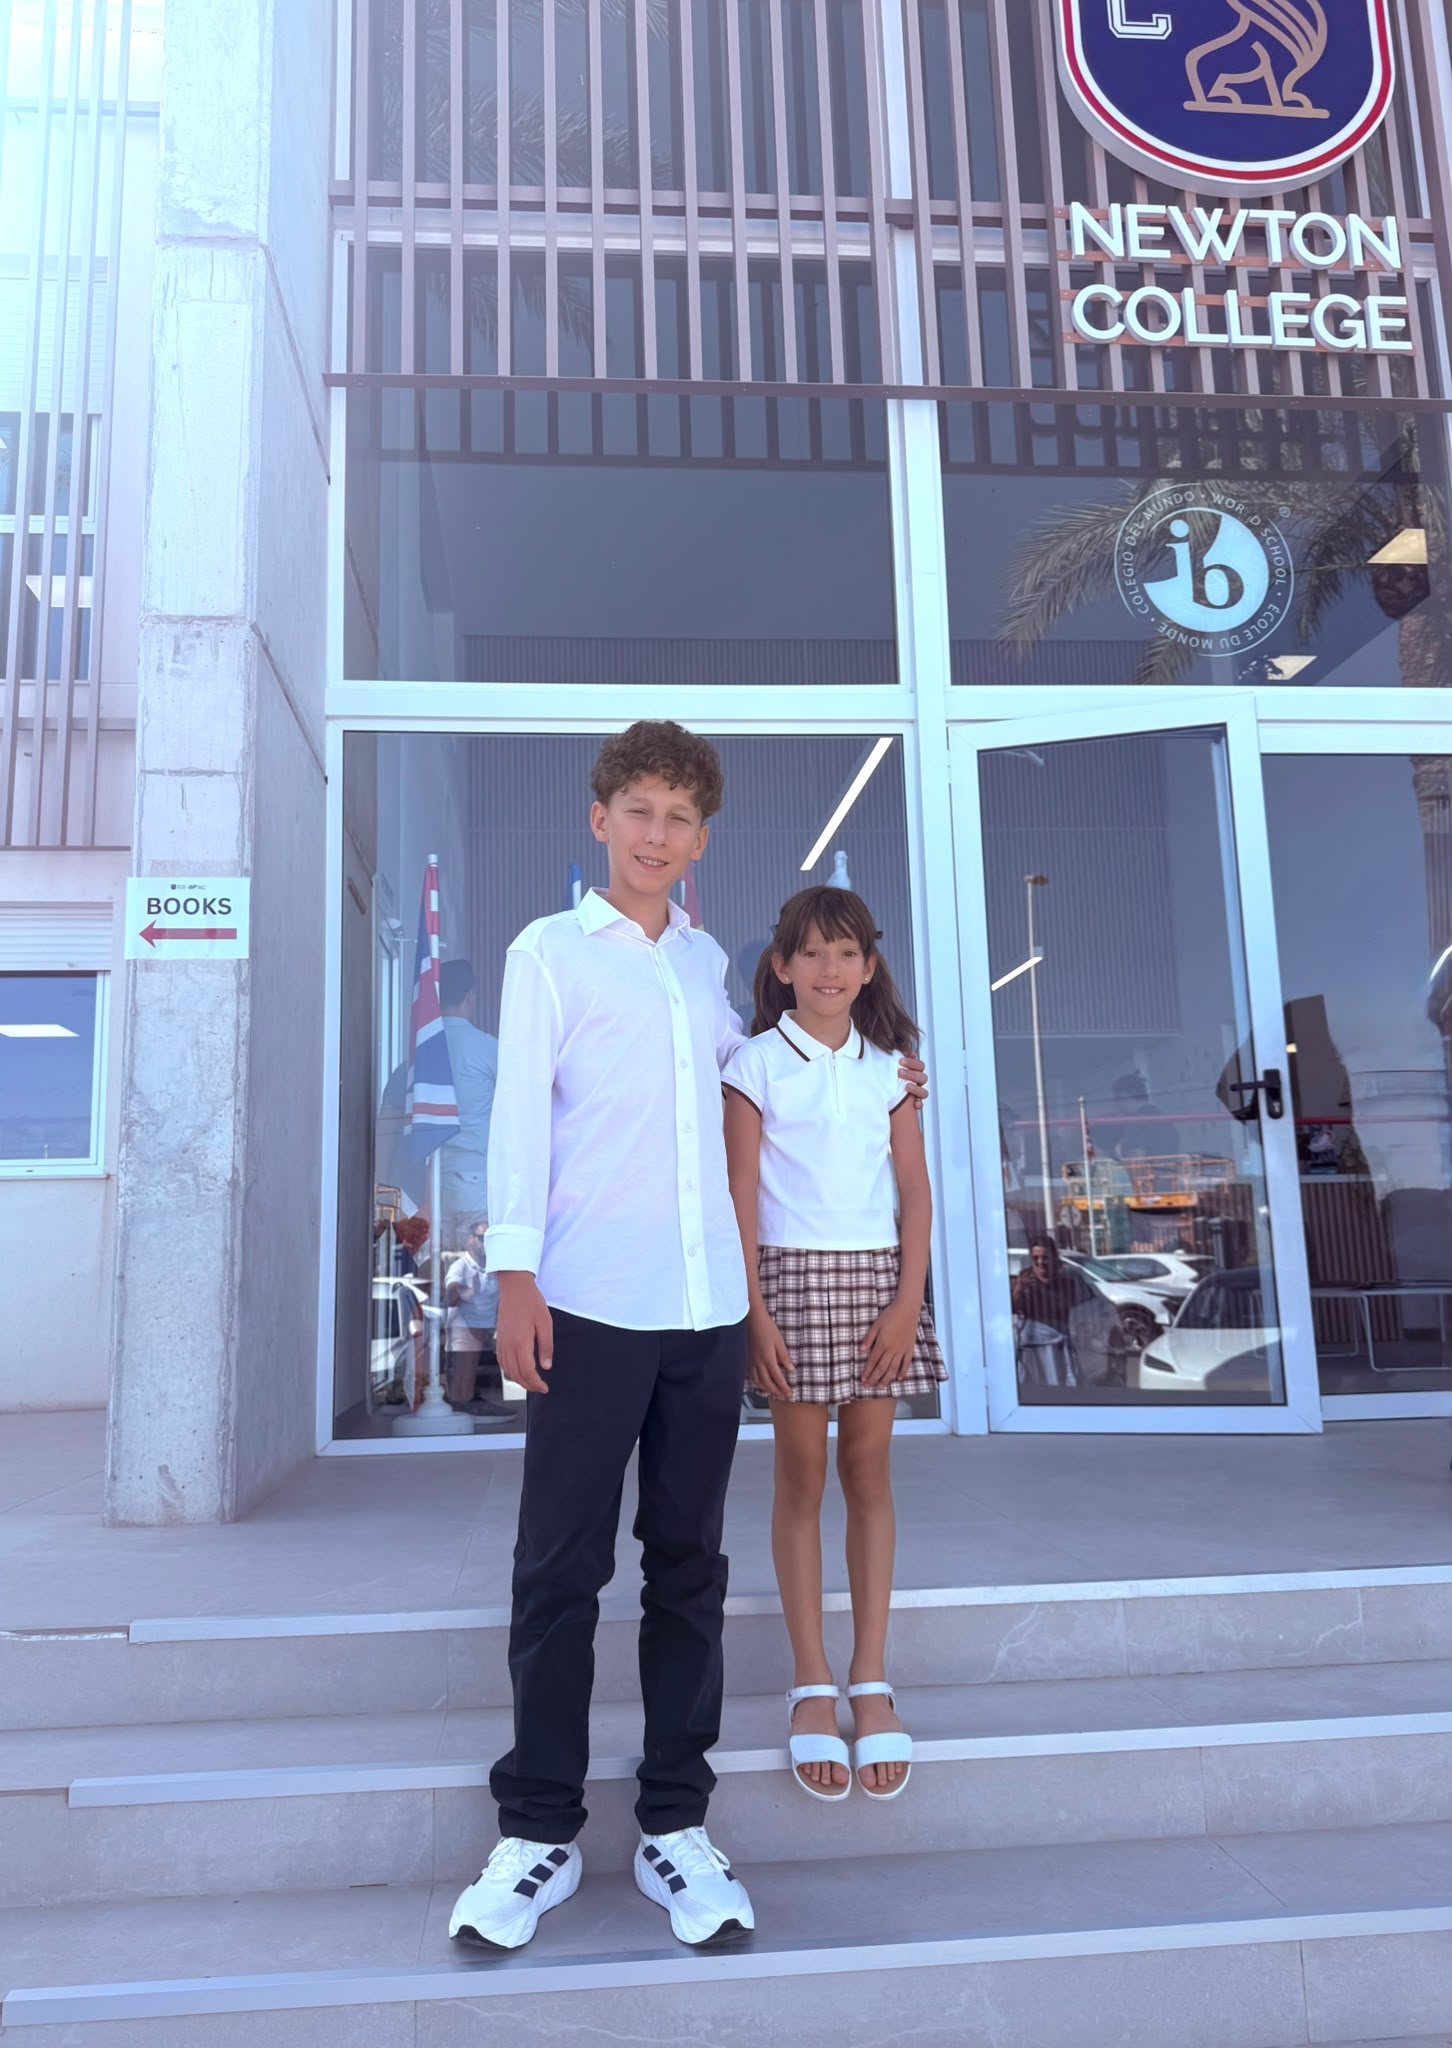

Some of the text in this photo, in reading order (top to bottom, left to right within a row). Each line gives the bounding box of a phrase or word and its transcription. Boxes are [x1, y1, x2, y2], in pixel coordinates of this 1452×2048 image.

[1070, 201, 1402, 271] NEWTON
[1071, 284, 1413, 352] COLLEGE
[1122, 491, 1195, 614] COLEGIO DEL MUNDO
[1212, 492, 1287, 585] WORD SCHOOL
[1157, 622, 1213, 649] MONDE
[1220, 634, 1241, 649] DU
[147, 897, 232, 915] BOOKS
